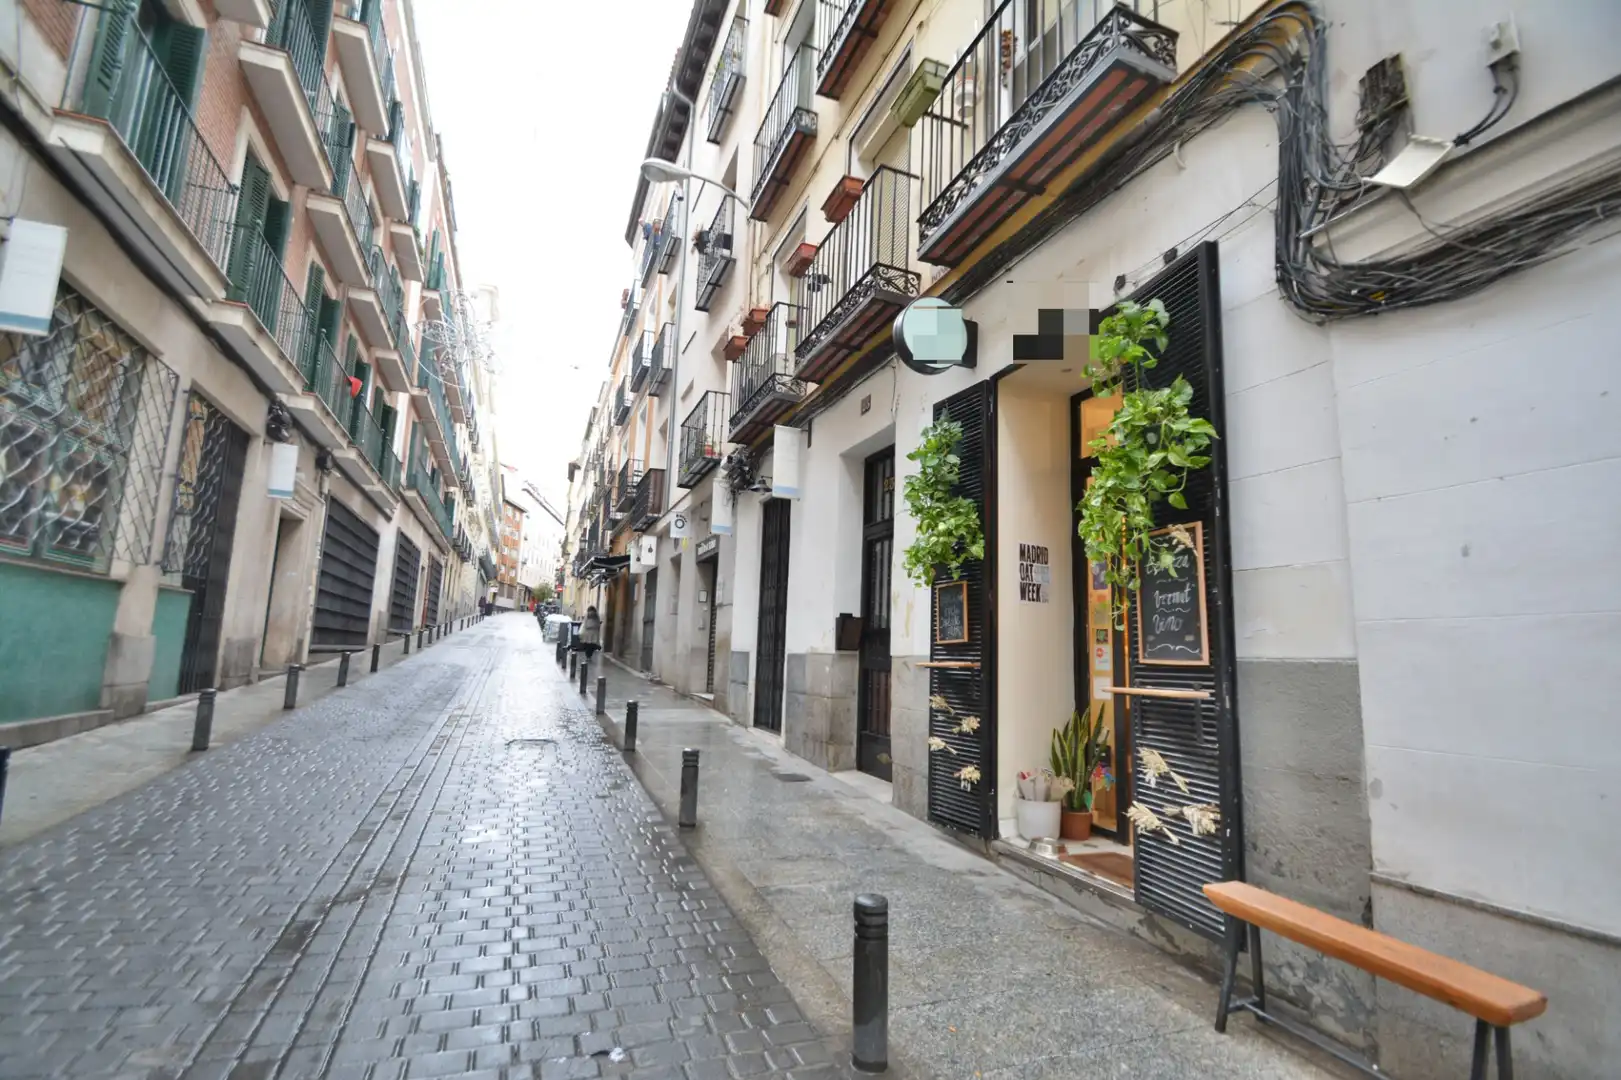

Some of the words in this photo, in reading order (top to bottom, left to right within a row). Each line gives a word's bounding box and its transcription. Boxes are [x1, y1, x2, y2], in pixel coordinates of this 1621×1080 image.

[1019, 543, 1049, 565] MADRID
[1019, 563, 1034, 582] OAT
[1019, 582, 1042, 602] WEEK
